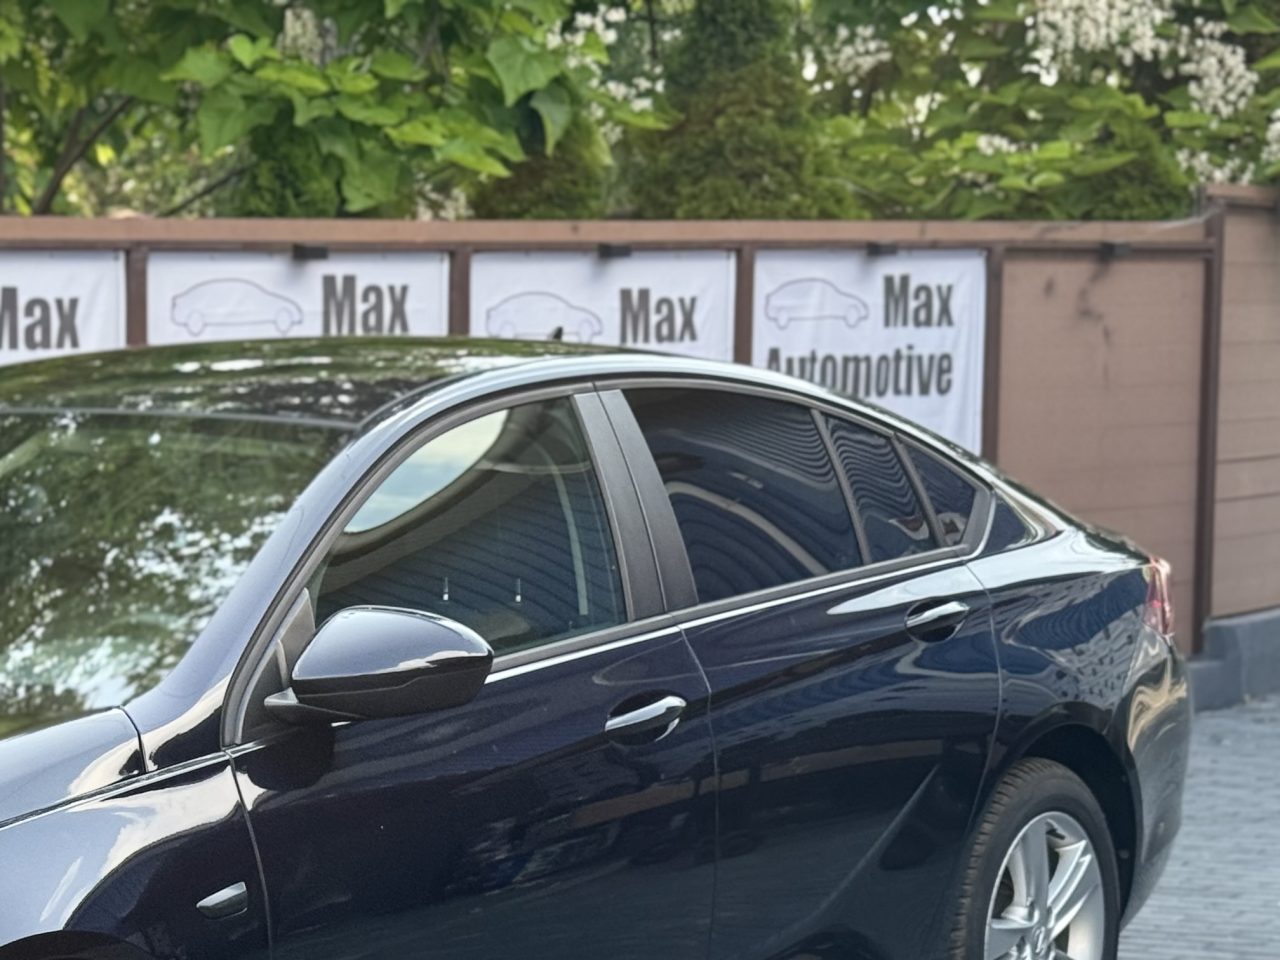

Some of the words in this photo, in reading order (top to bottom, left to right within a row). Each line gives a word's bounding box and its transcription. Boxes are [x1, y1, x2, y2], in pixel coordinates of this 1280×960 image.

[322, 274, 410, 336] Max
[620, 287, 697, 344] Max
[883, 274, 954, 328] Max
